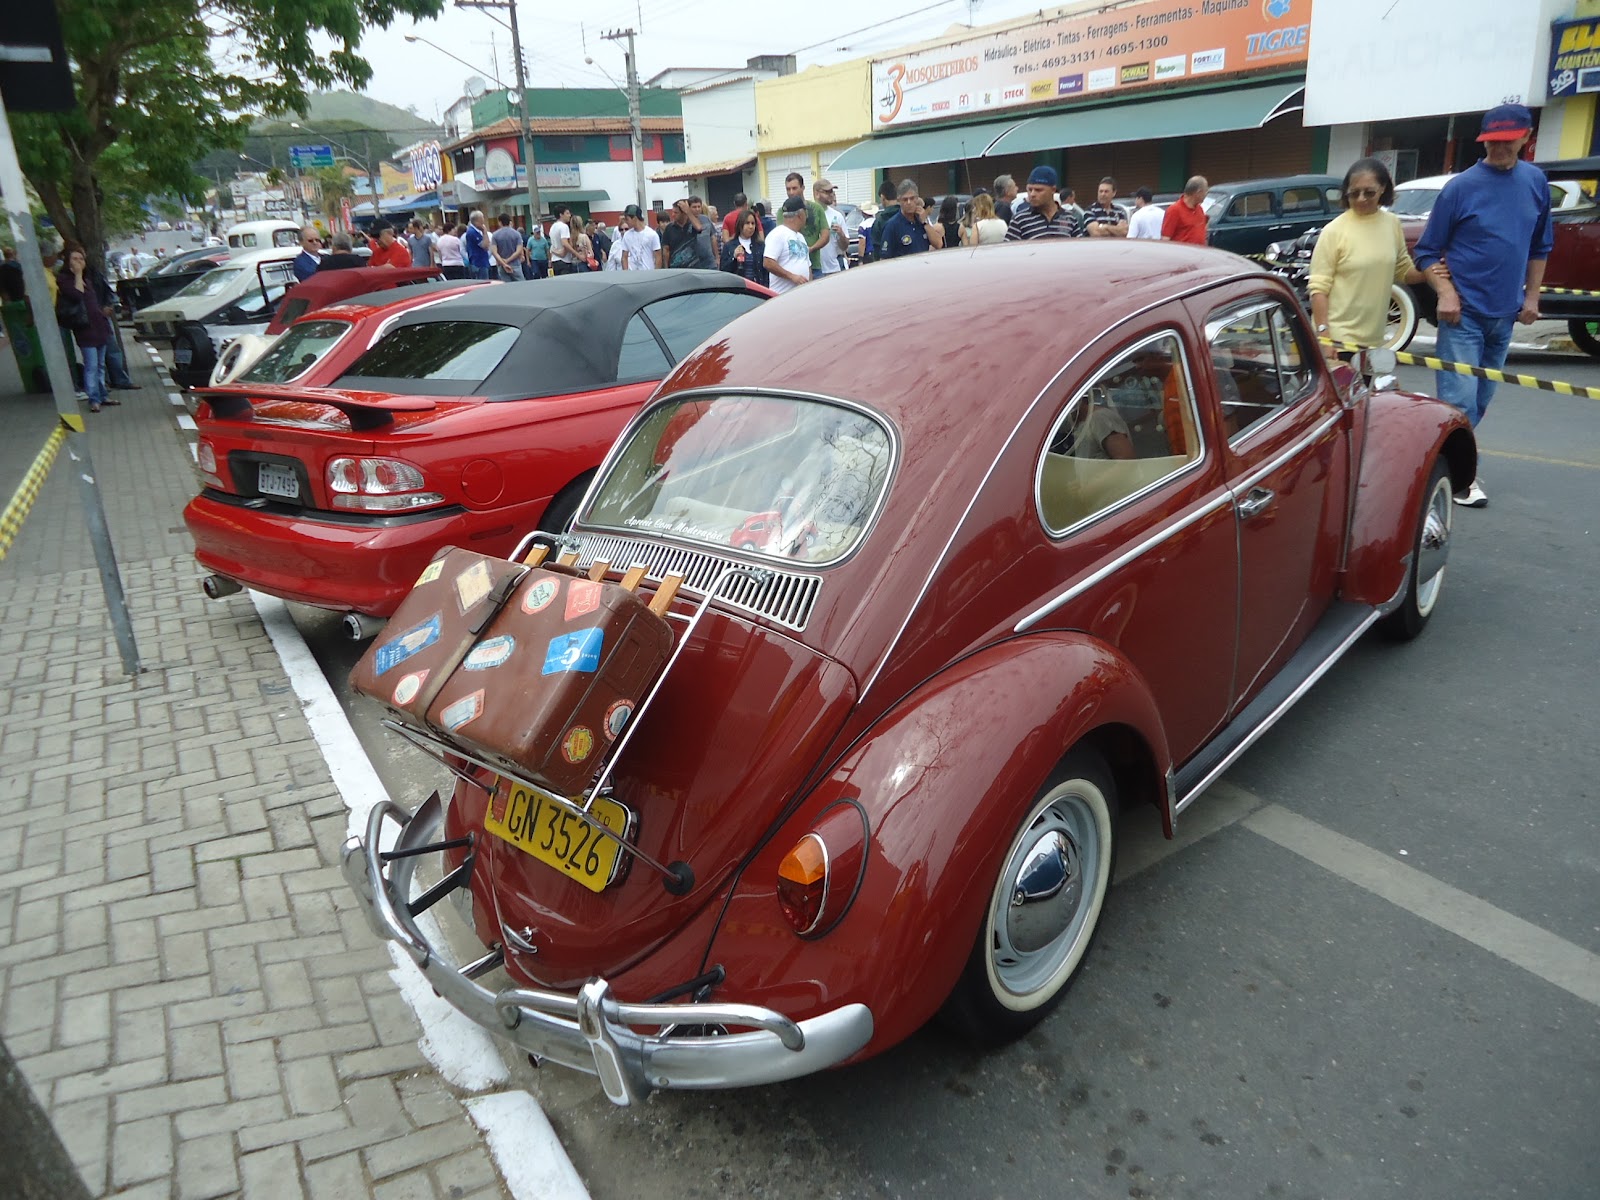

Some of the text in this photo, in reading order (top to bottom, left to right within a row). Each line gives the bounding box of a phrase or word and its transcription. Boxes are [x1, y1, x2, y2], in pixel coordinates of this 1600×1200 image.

[983, 44, 1018, 62] Hidráulica
[1023, 37, 1051, 54] Elétrica
[1057, 31, 1081, 45] Tintas
[1087, 20, 1128, 40] Ferragens
[1136, 7, 1193, 30] Ferramentas
[1246, 24, 1310, 55] TIGRE
[1041, 50, 1096, 70] 4693-3131
[1106, 35, 1168, 56] 4695-1300
[879, 56, 979, 123] 3 MOSQUETEIROS
[1004, 88, 1025, 99] STECK
[653, 518, 673, 531] Com
[540, 804, 605, 876] 3526
